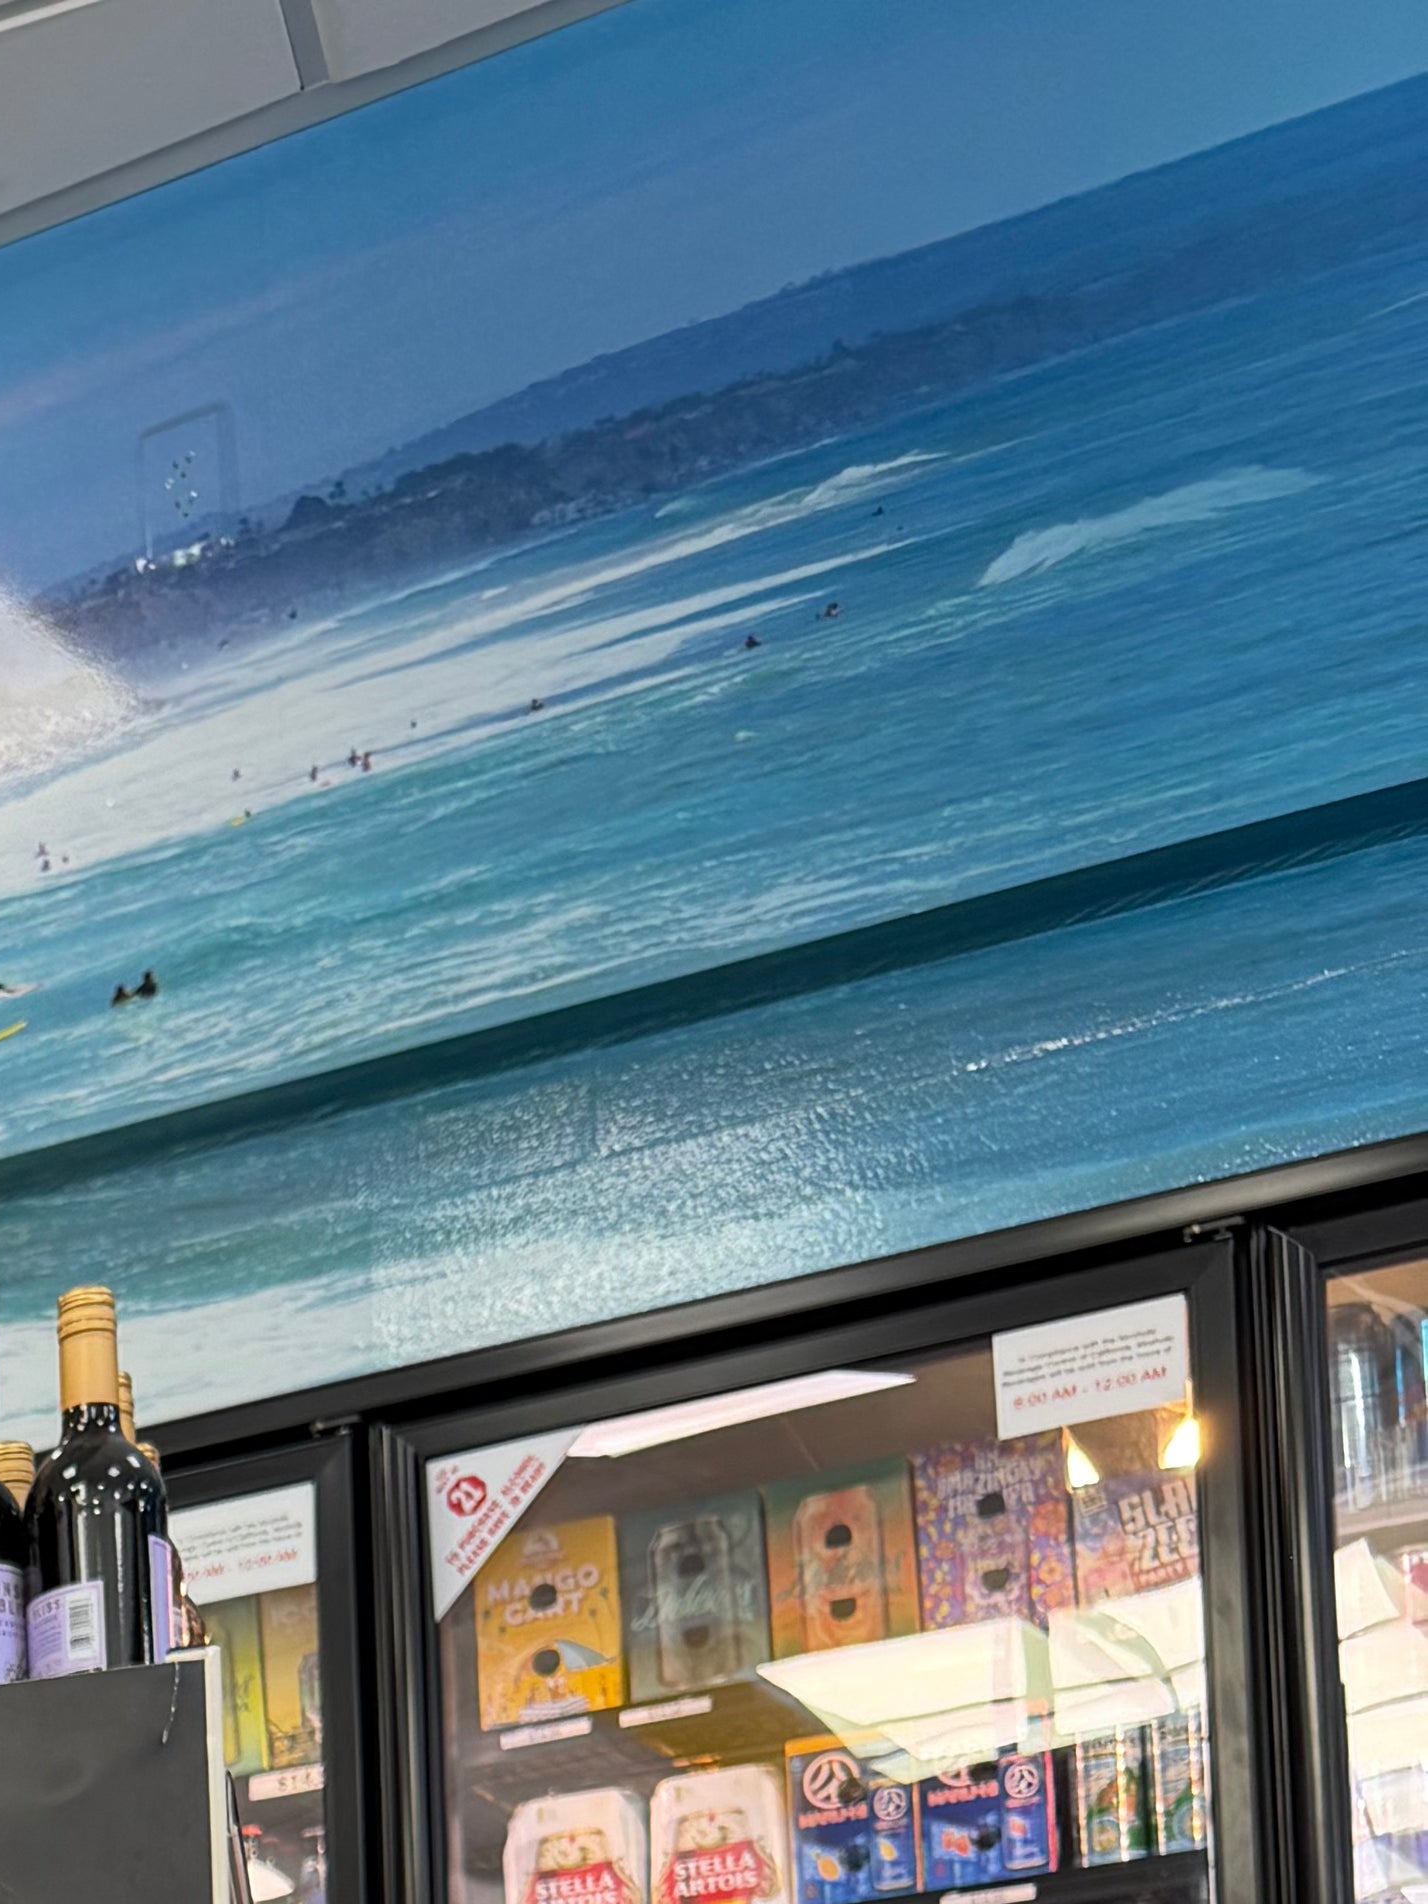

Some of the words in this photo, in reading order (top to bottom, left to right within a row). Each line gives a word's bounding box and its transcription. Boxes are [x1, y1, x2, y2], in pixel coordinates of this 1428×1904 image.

[450, 1481, 483, 1513] 21
[674, 1854, 756, 1882] STELLA
[535, 1873, 615, 1901] STELLA
[674, 1873, 758, 1898] ARTOIS
